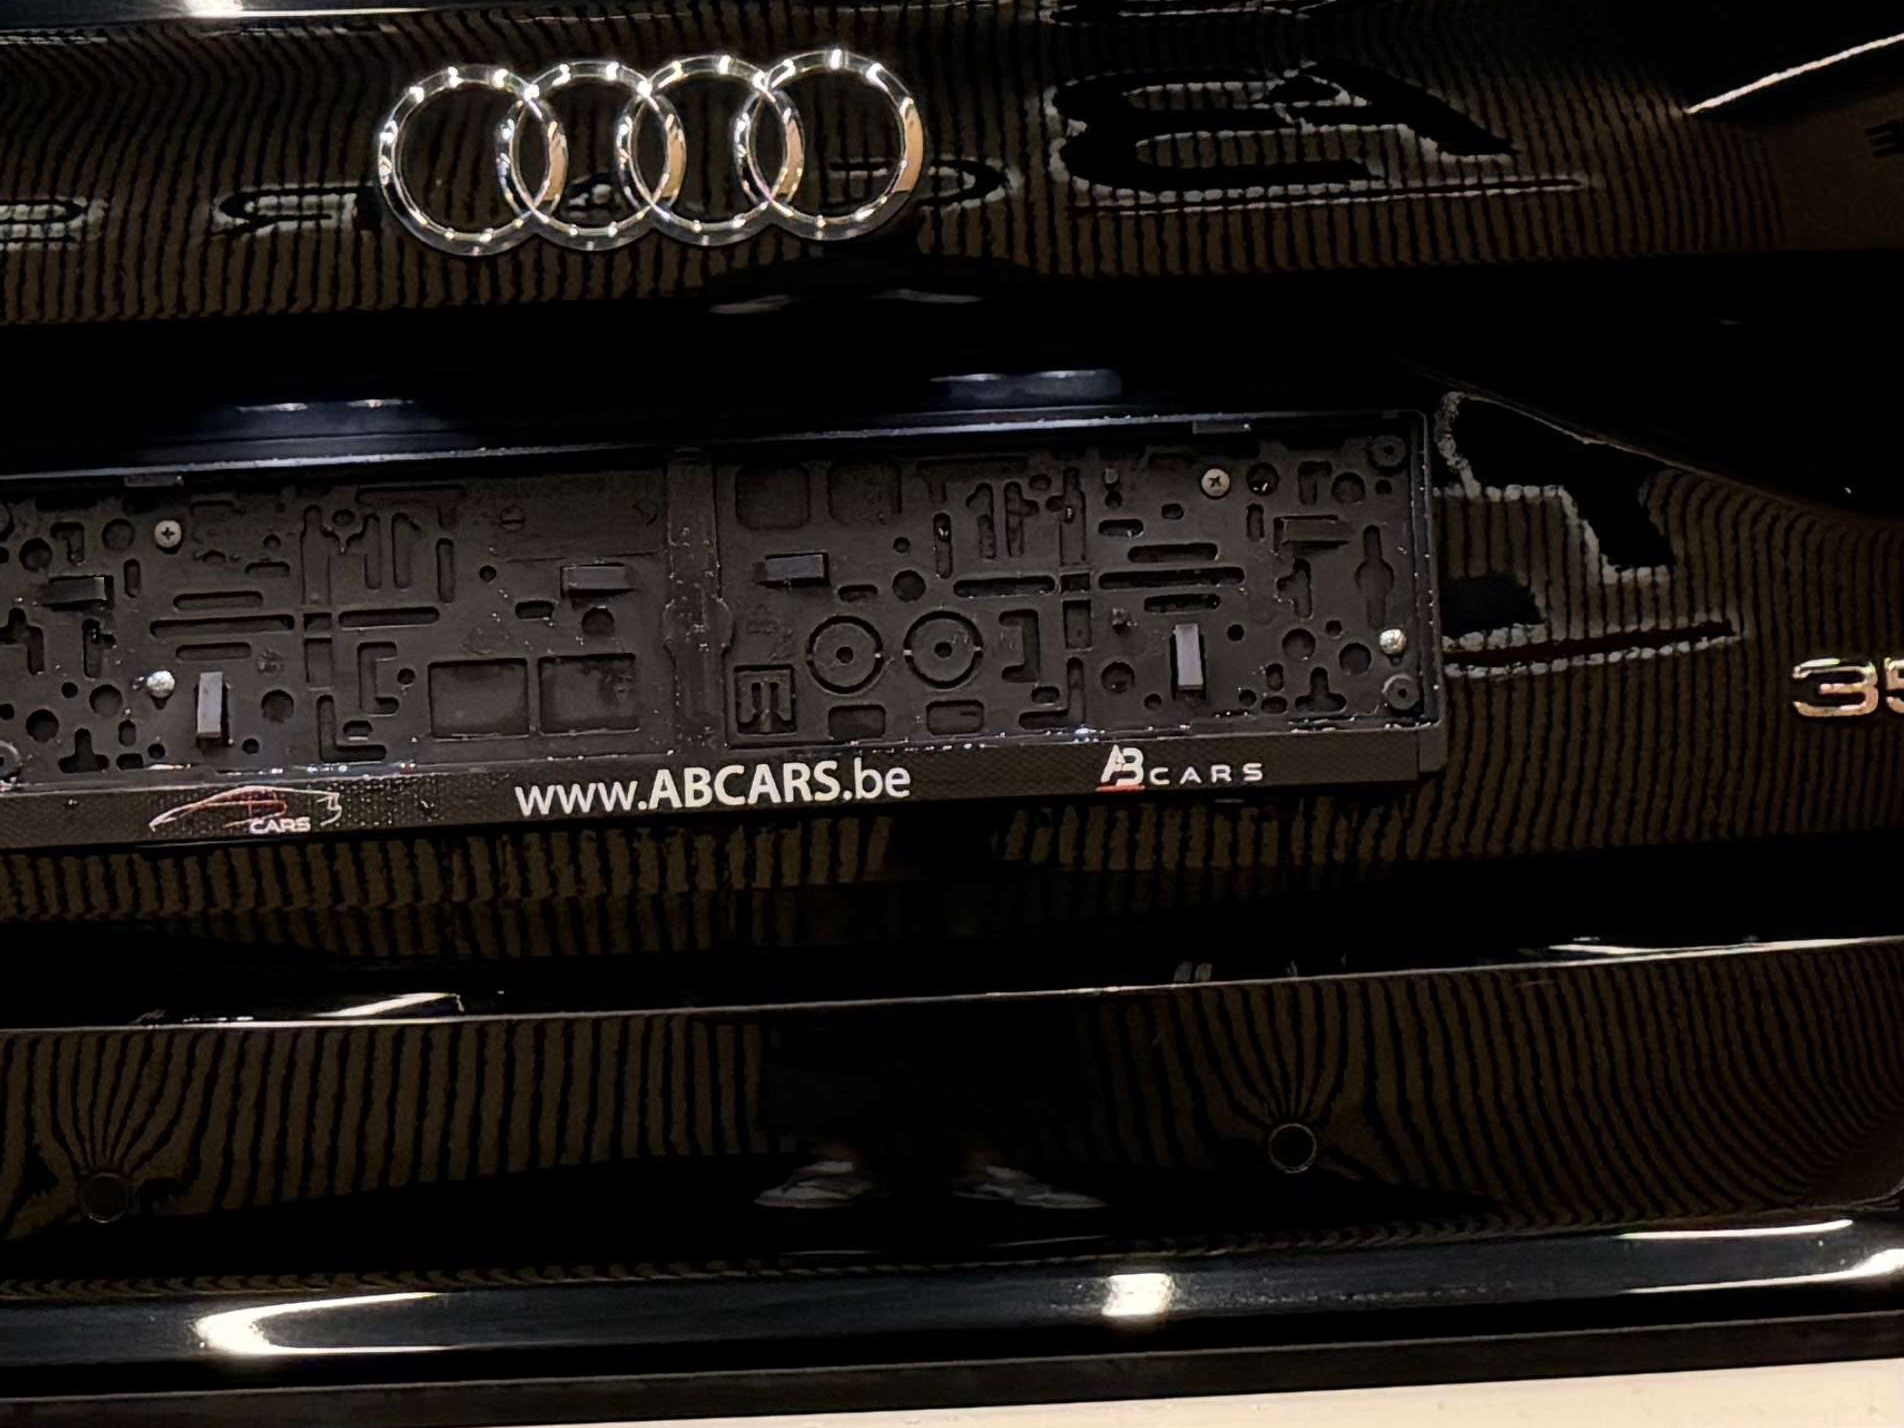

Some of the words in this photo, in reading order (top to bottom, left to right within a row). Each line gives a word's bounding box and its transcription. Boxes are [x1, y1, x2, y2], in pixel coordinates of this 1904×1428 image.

[1149, 763, 1264, 786] CARS
[514, 757, 912, 818] www.ABCARS.be
[248, 817, 311, 835] CARS
